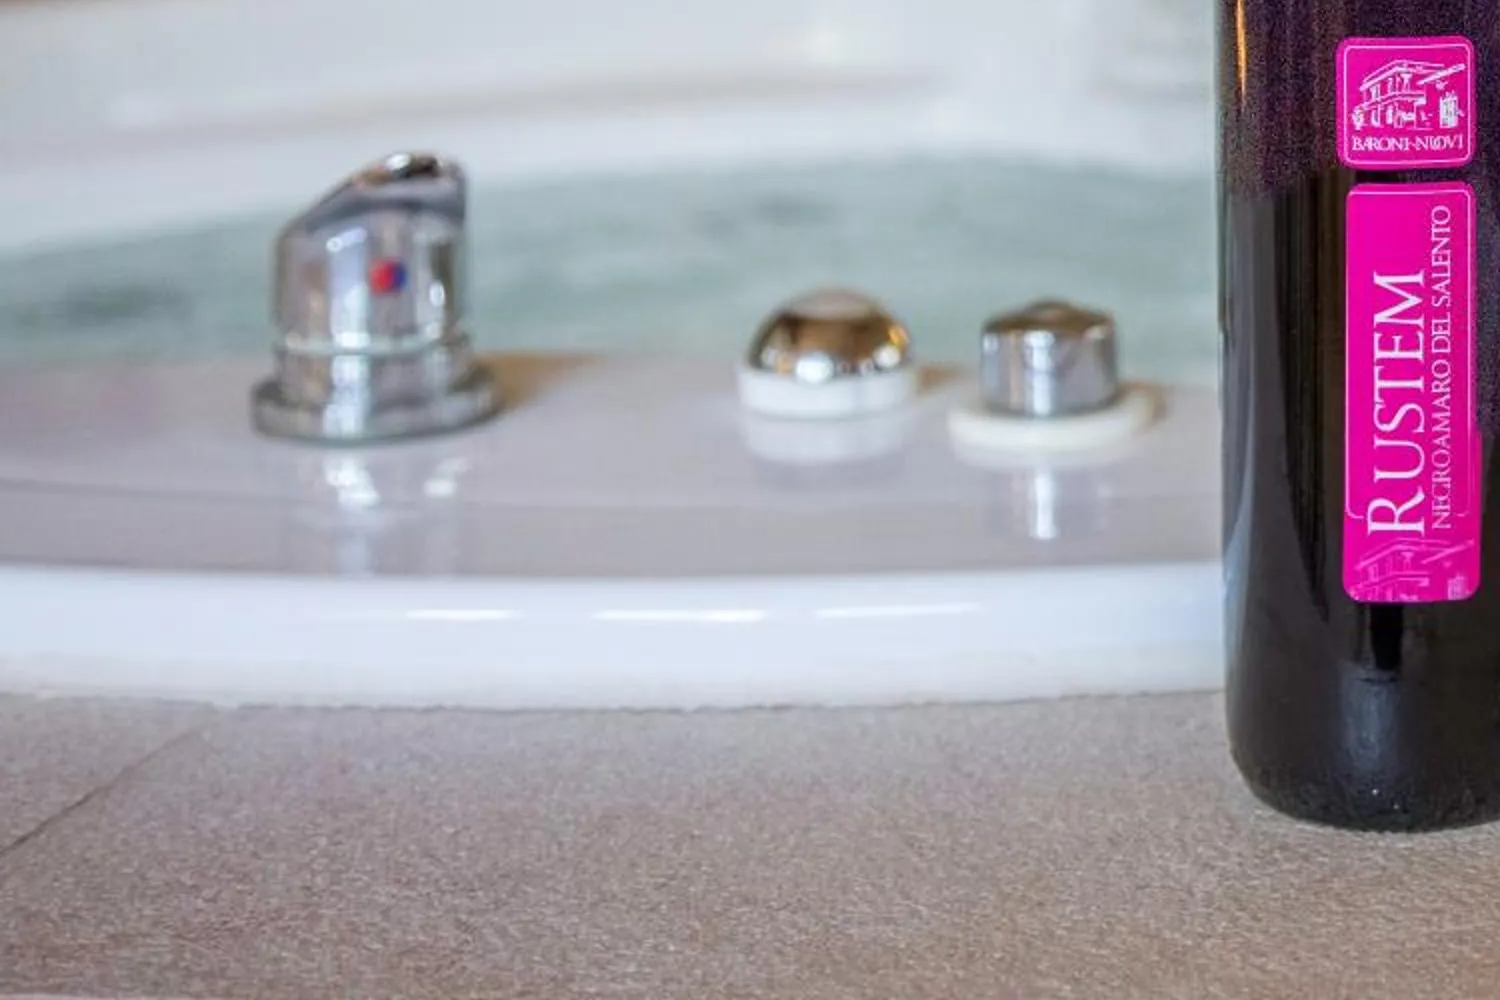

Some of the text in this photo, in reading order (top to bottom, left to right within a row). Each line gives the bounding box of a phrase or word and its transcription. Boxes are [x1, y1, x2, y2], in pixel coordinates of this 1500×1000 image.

[1367, 270, 1424, 536] RUSTEM
[1431, 205, 1452, 529] NEGROAMARO DEL SALENTO
